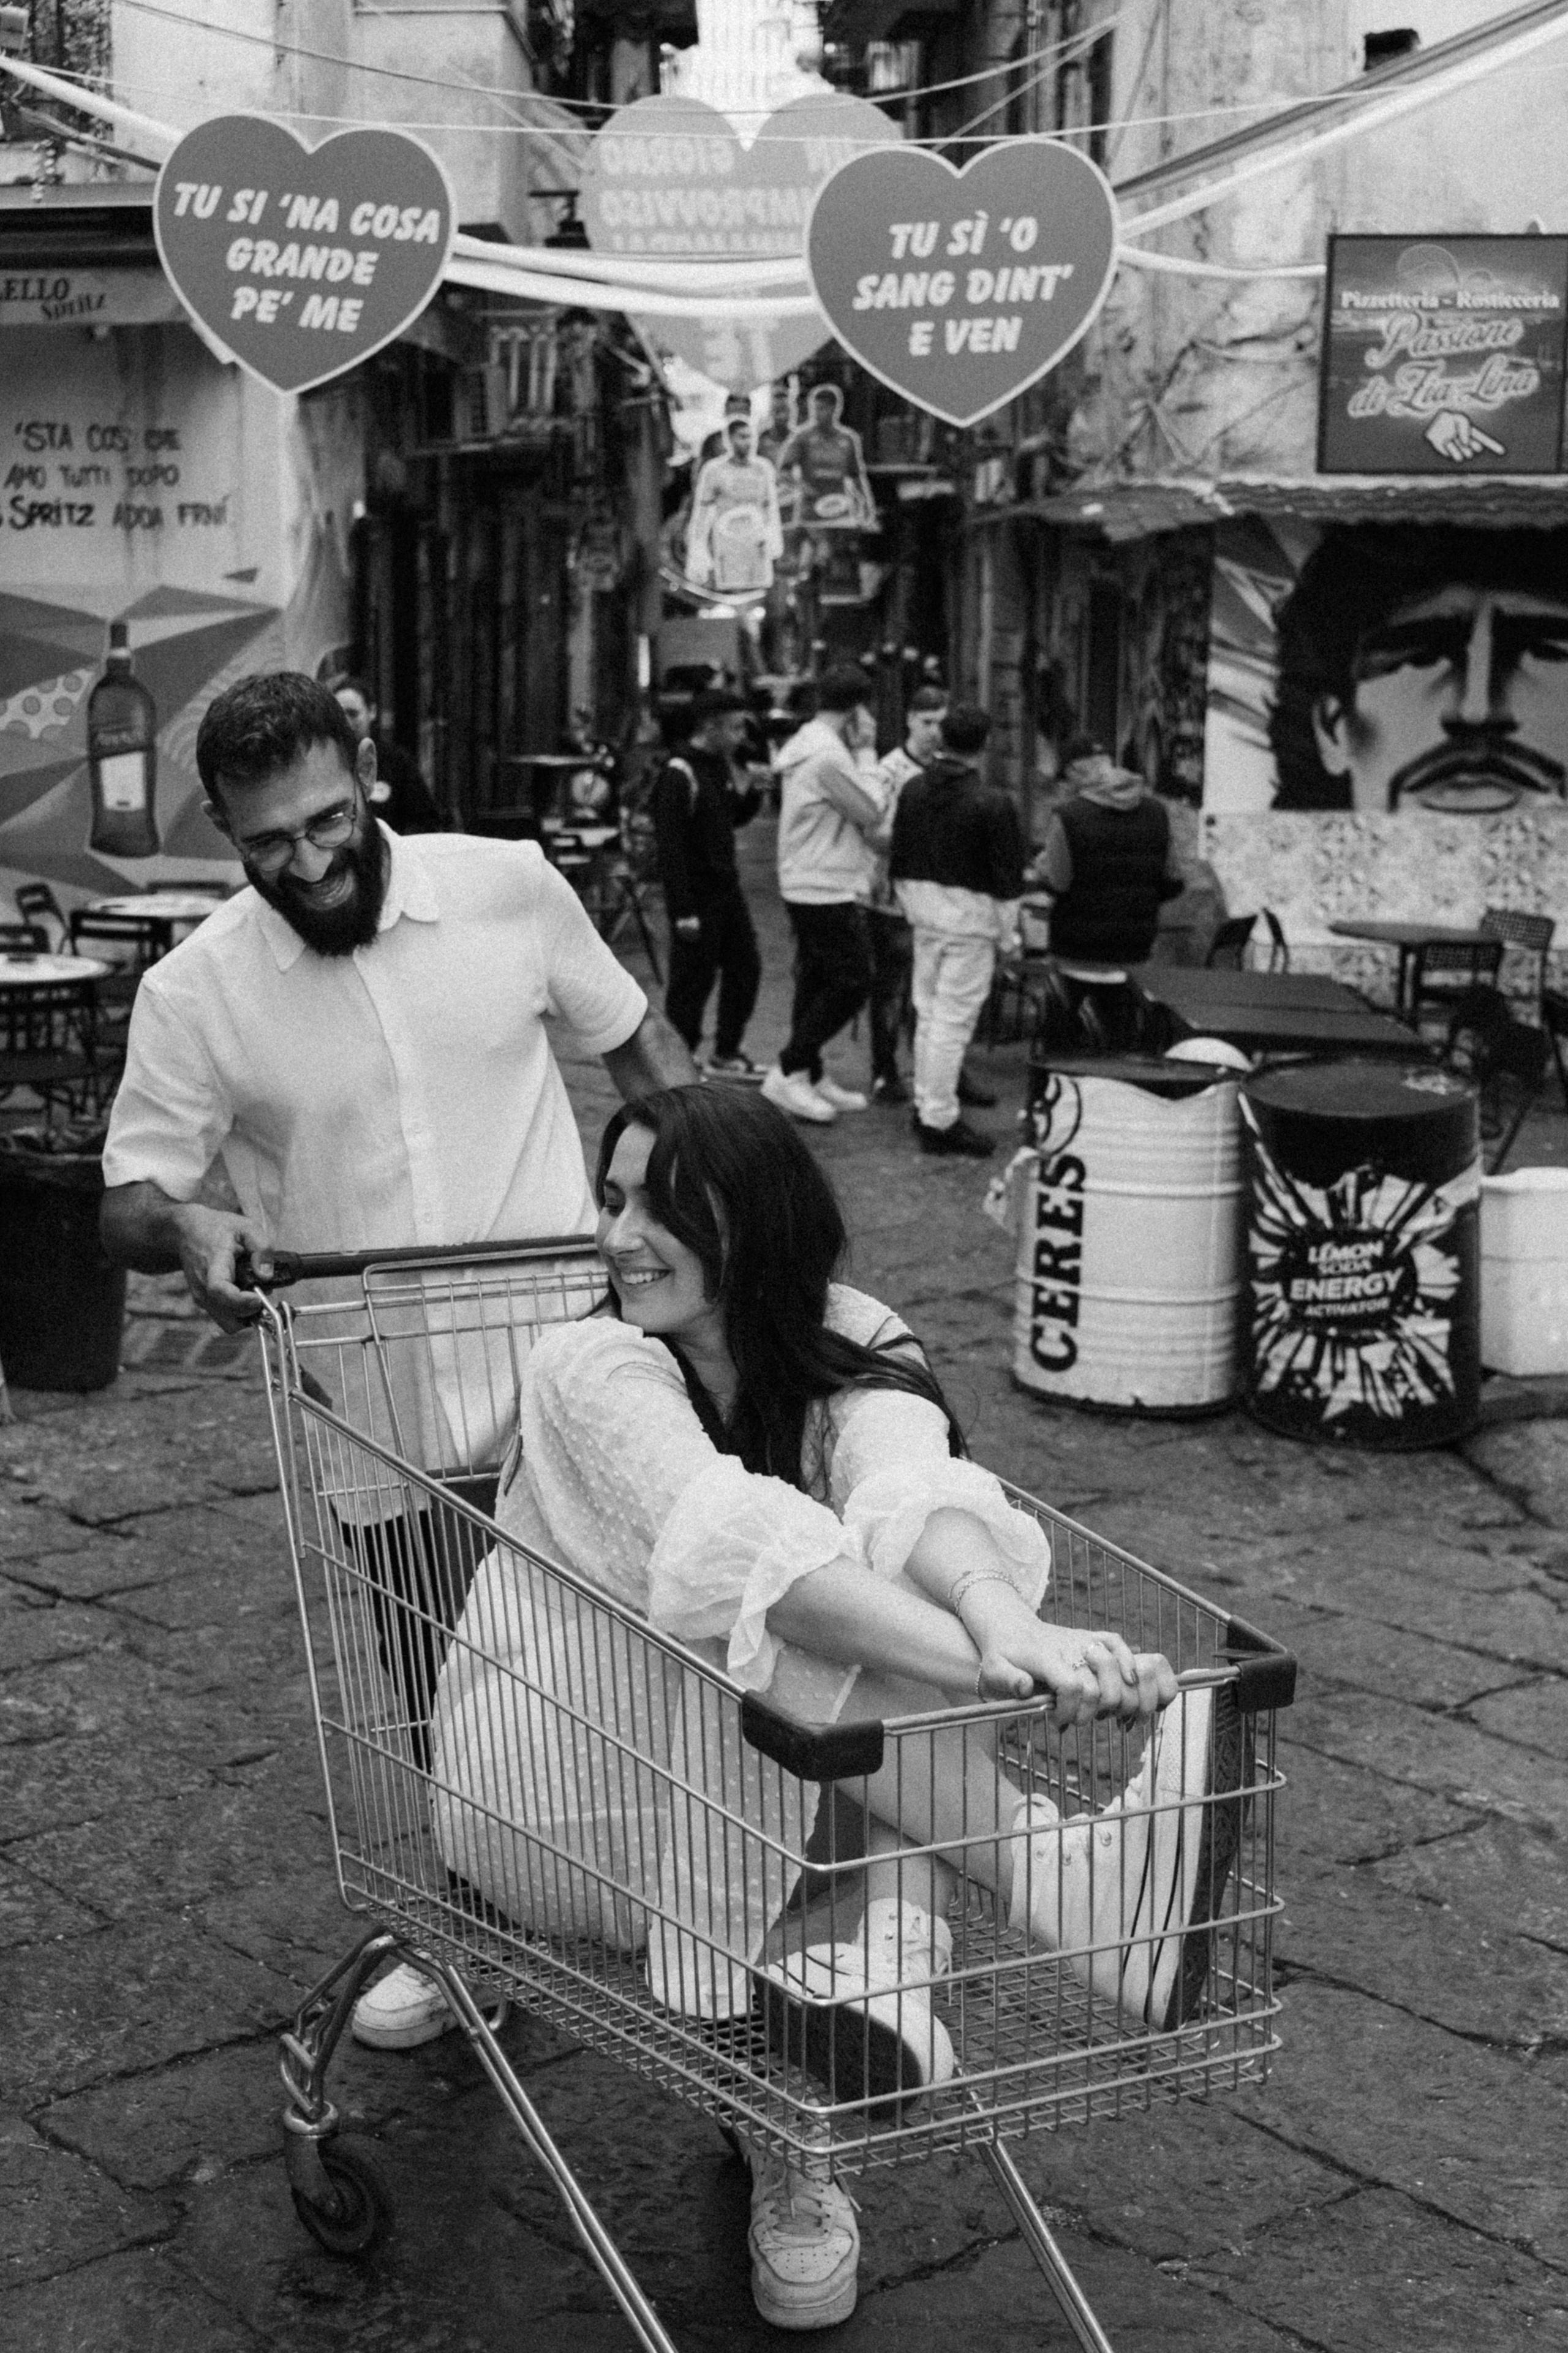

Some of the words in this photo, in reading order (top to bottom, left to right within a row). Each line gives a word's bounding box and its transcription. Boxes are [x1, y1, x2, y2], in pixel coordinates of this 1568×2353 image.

[173, 183, 222, 219] TU
[226, 188, 268, 224] SI
[278, 193, 339, 233] 'NA
[349, 202, 441, 244] COSA
[888, 221, 941, 259] TU
[946, 210, 990, 256] SÌ
[998, 216, 1039, 252] 'O
[225, 238, 380, 285] GRANDE
[0, 278, 70, 301] ELLO
[230, 285, 295, 324] PE'
[298, 295, 364, 333] ME
[851, 270, 956, 311] SANG
[966, 263, 1075, 304] DINT'
[908, 320, 935, 357] E
[944, 315, 1023, 355] VEN
[1365, 309, 1523, 369] Passione
[1348, 375, 1387, 418] di
[1387, 359, 1455, 418] Zia
[1457, 353, 1540, 409] Lina
[1030, 1154, 1086, 1373] CERES
[1290, 1267, 1405, 1301] ENERGY
